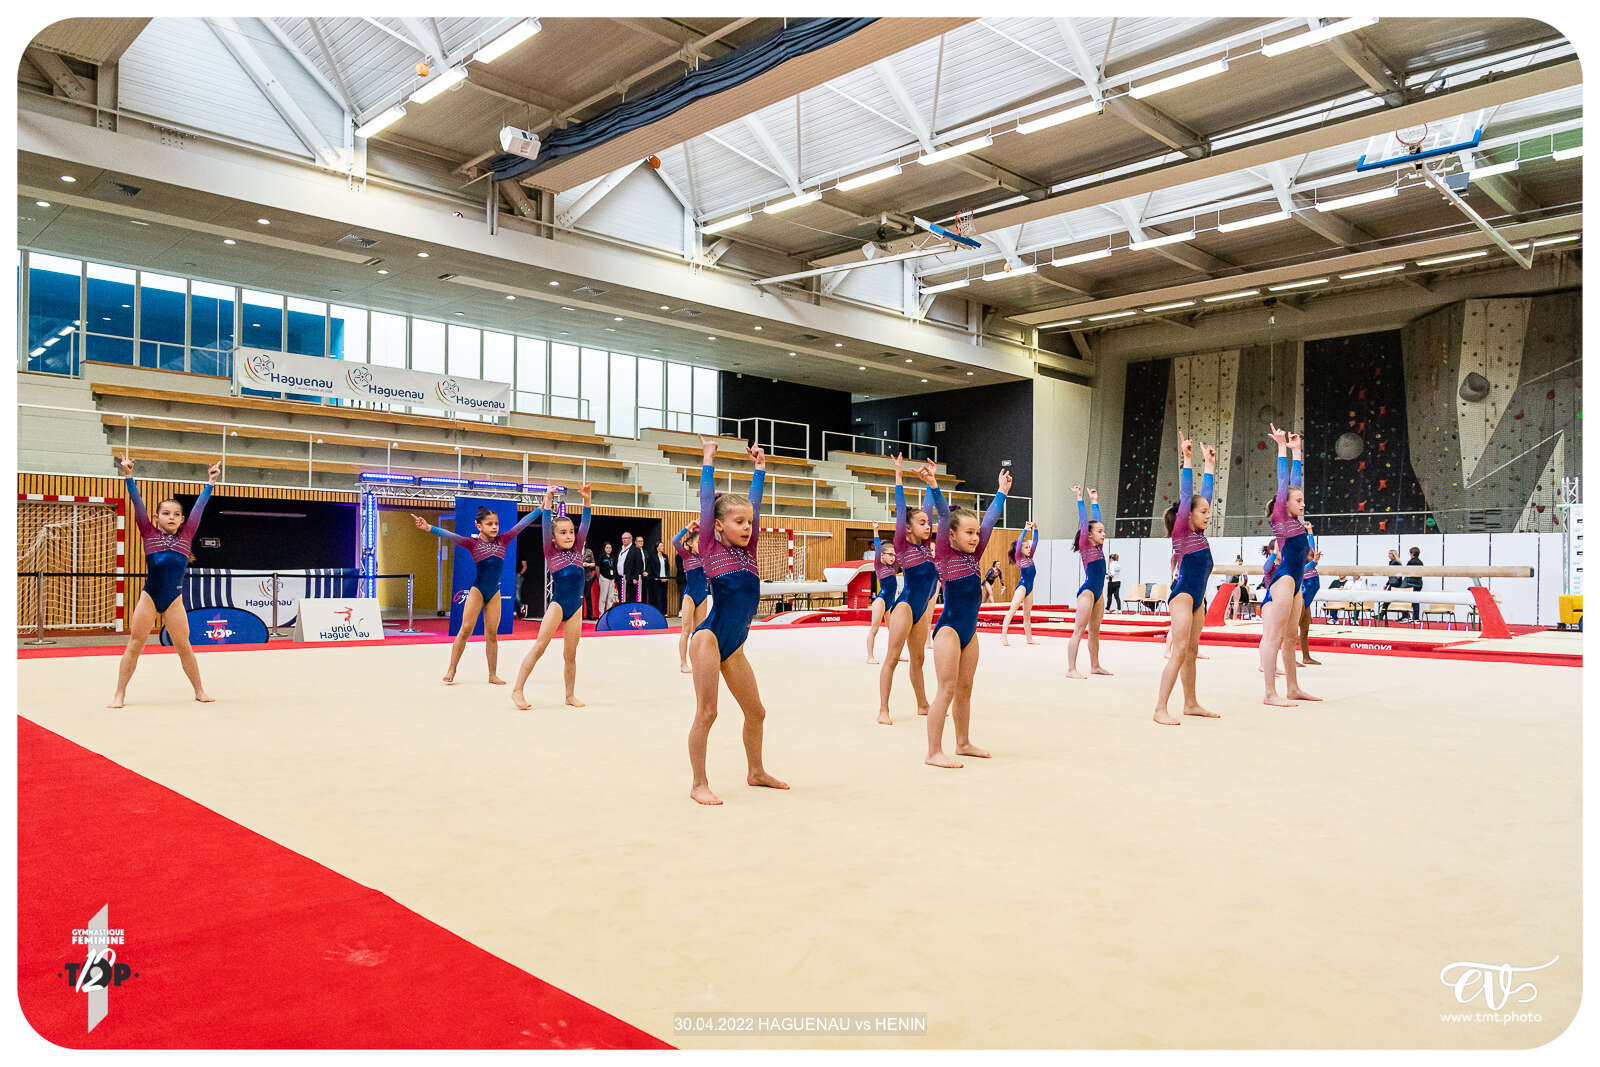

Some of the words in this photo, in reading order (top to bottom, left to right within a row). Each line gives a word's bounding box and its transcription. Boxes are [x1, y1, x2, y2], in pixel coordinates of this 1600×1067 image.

[270, 372, 333, 389] Haguenau
[368, 385, 425, 400] Haguenau
[456, 396, 505, 409] Haguenau
